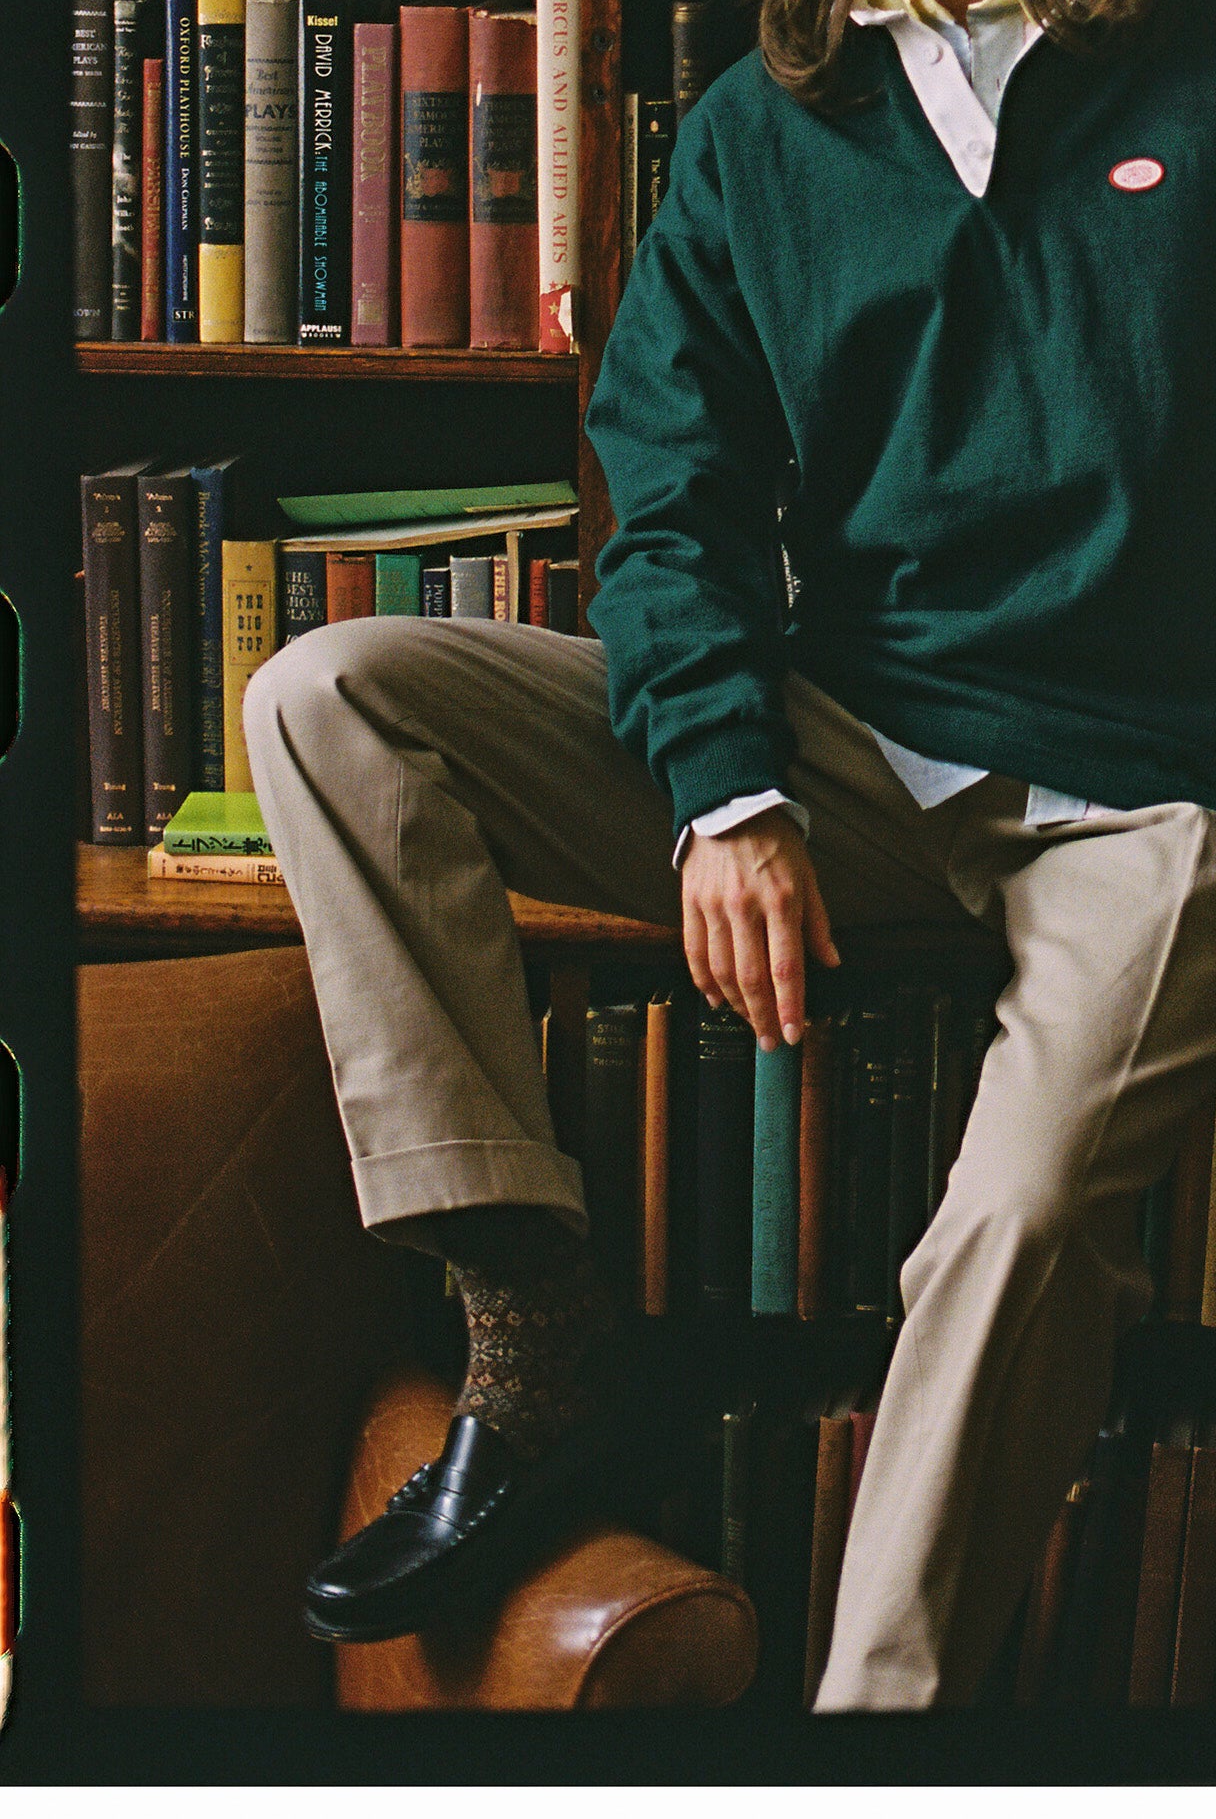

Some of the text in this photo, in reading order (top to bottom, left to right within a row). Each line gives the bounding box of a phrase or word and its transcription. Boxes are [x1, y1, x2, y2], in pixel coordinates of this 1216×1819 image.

[74, 30, 96, 39] BEST
[307, 15, 338, 27] Kissel
[73, 56, 98, 65] PLAYS
[180, 16, 191, 159] OXFORD PLAYHOUSE
[552, 67, 568, 112] AND
[245, 103, 299, 120] PLAYS
[361, 46, 387, 183] PLAYBOOK
[314, 34, 332, 311] DAVID MERRICK: THE ABOMINABLE SHOWMAN
[552, 122, 568, 200] ALLIED
[552, 211, 568, 264] ARTS
[174, 310, 195, 319] STR
[198, 491, 211, 536] Brooks
[236, 594, 263, 609] THE
[494, 564, 506, 621] THE RO
[238, 614, 261, 630] BIG
[236, 636, 263, 651] TOP
